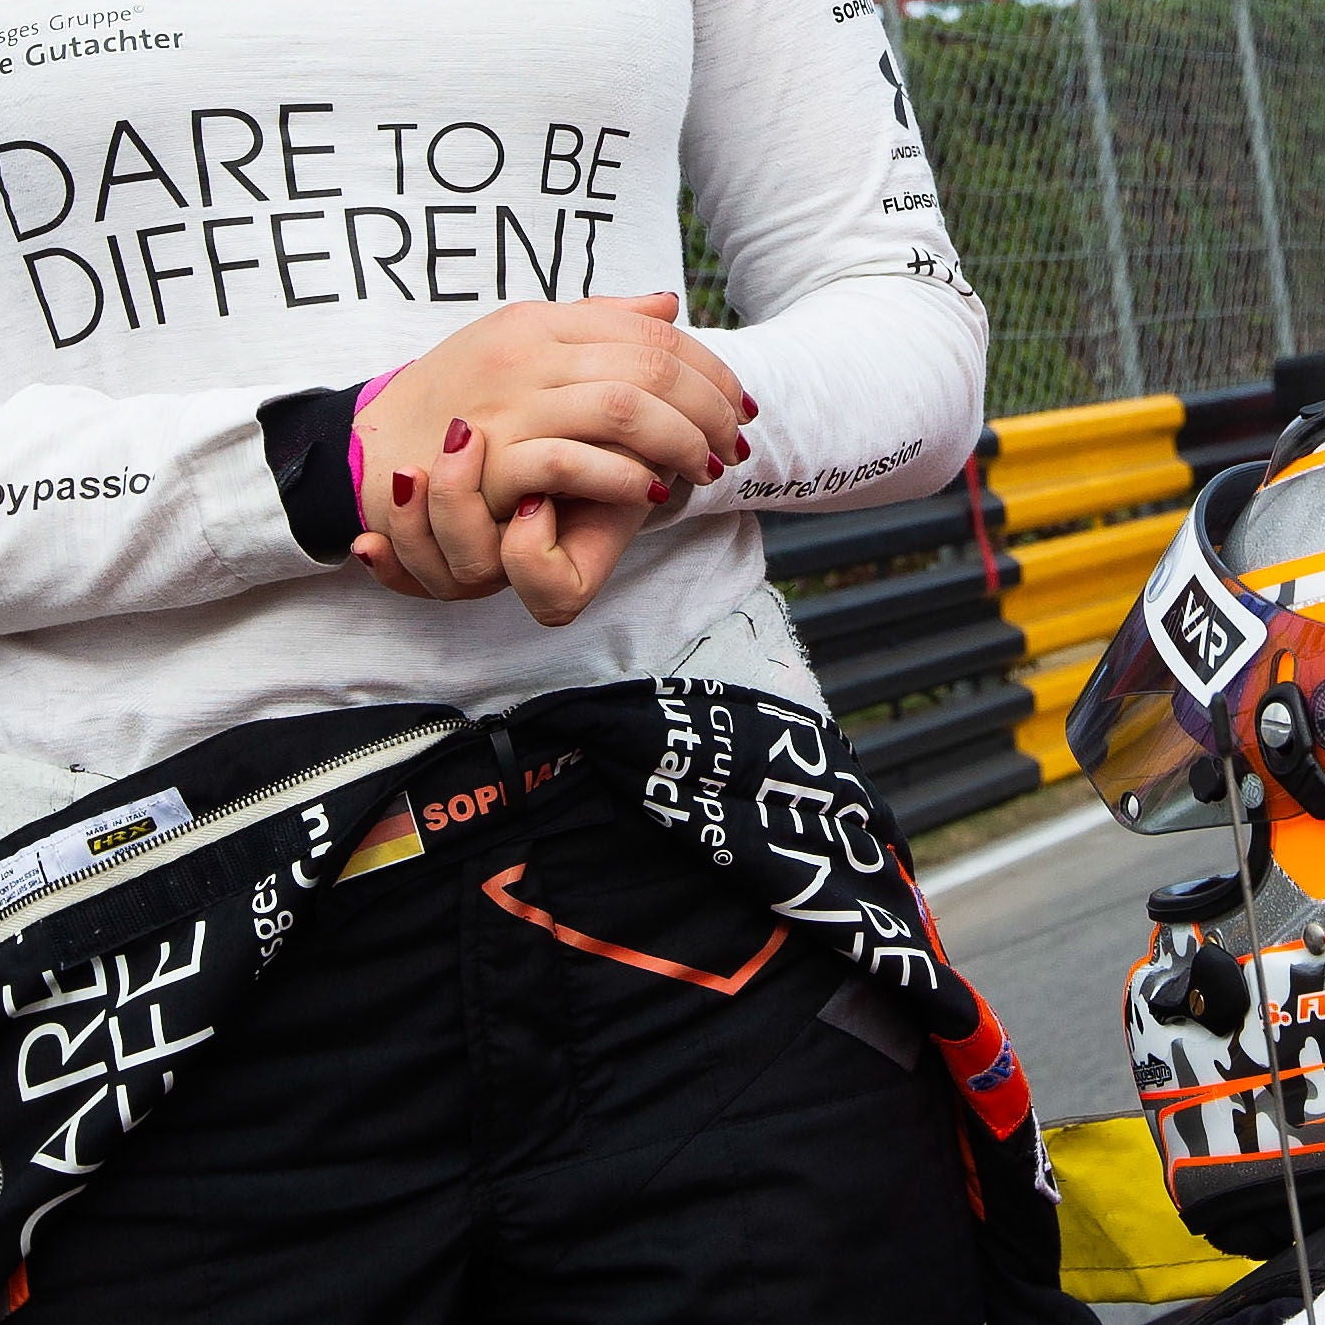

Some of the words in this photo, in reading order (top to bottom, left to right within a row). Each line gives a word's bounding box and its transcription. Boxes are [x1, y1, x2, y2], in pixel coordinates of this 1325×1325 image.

[25, 28, 184, 67] Gutachter
[377, 121, 505, 195] TO
[540, 124, 631, 201] BE
[24, 205, 615, 349] DIFFERENT
[32, 465, 156, 511] passio
[823, 467, 854, 495] by
[849, 438, 923, 489] passion
[1182, 590, 1228, 670] VAR
[85, 824, 109, 837] MADE
[112, 819, 123, 828] IN
[125, 810, 149, 823] ITALY
[422, 762, 553, 832] SOPIA
